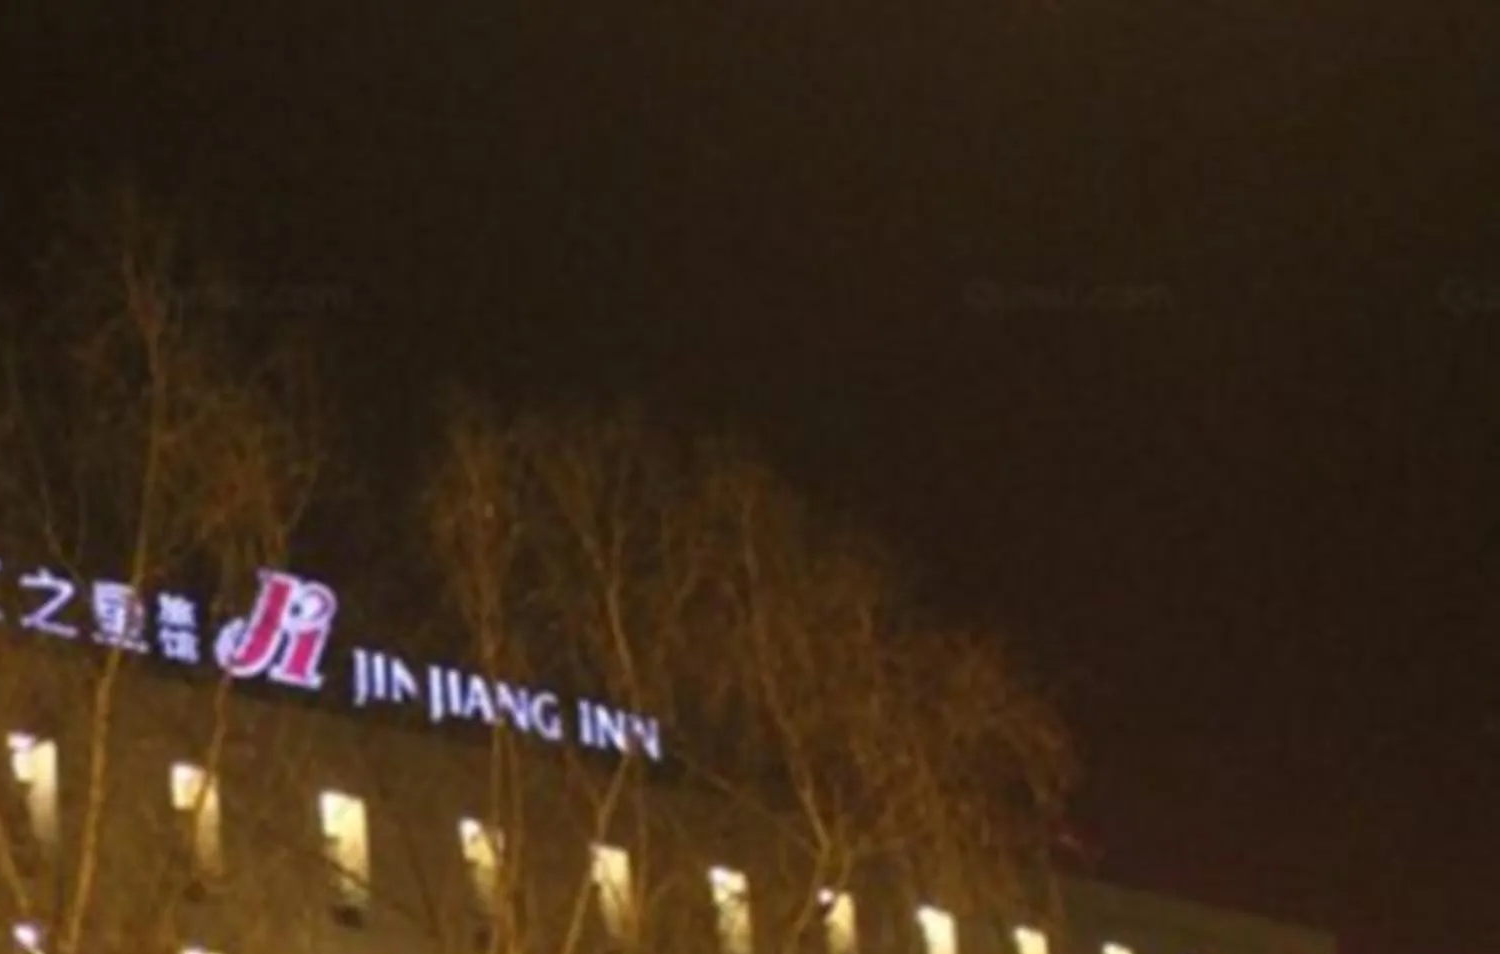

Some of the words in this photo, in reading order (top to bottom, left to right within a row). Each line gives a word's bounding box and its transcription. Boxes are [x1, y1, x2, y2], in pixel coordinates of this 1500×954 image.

[353, 648, 418, 706] JIN
[428, 664, 563, 742] JIANG
[577, 698, 661, 762] INN
